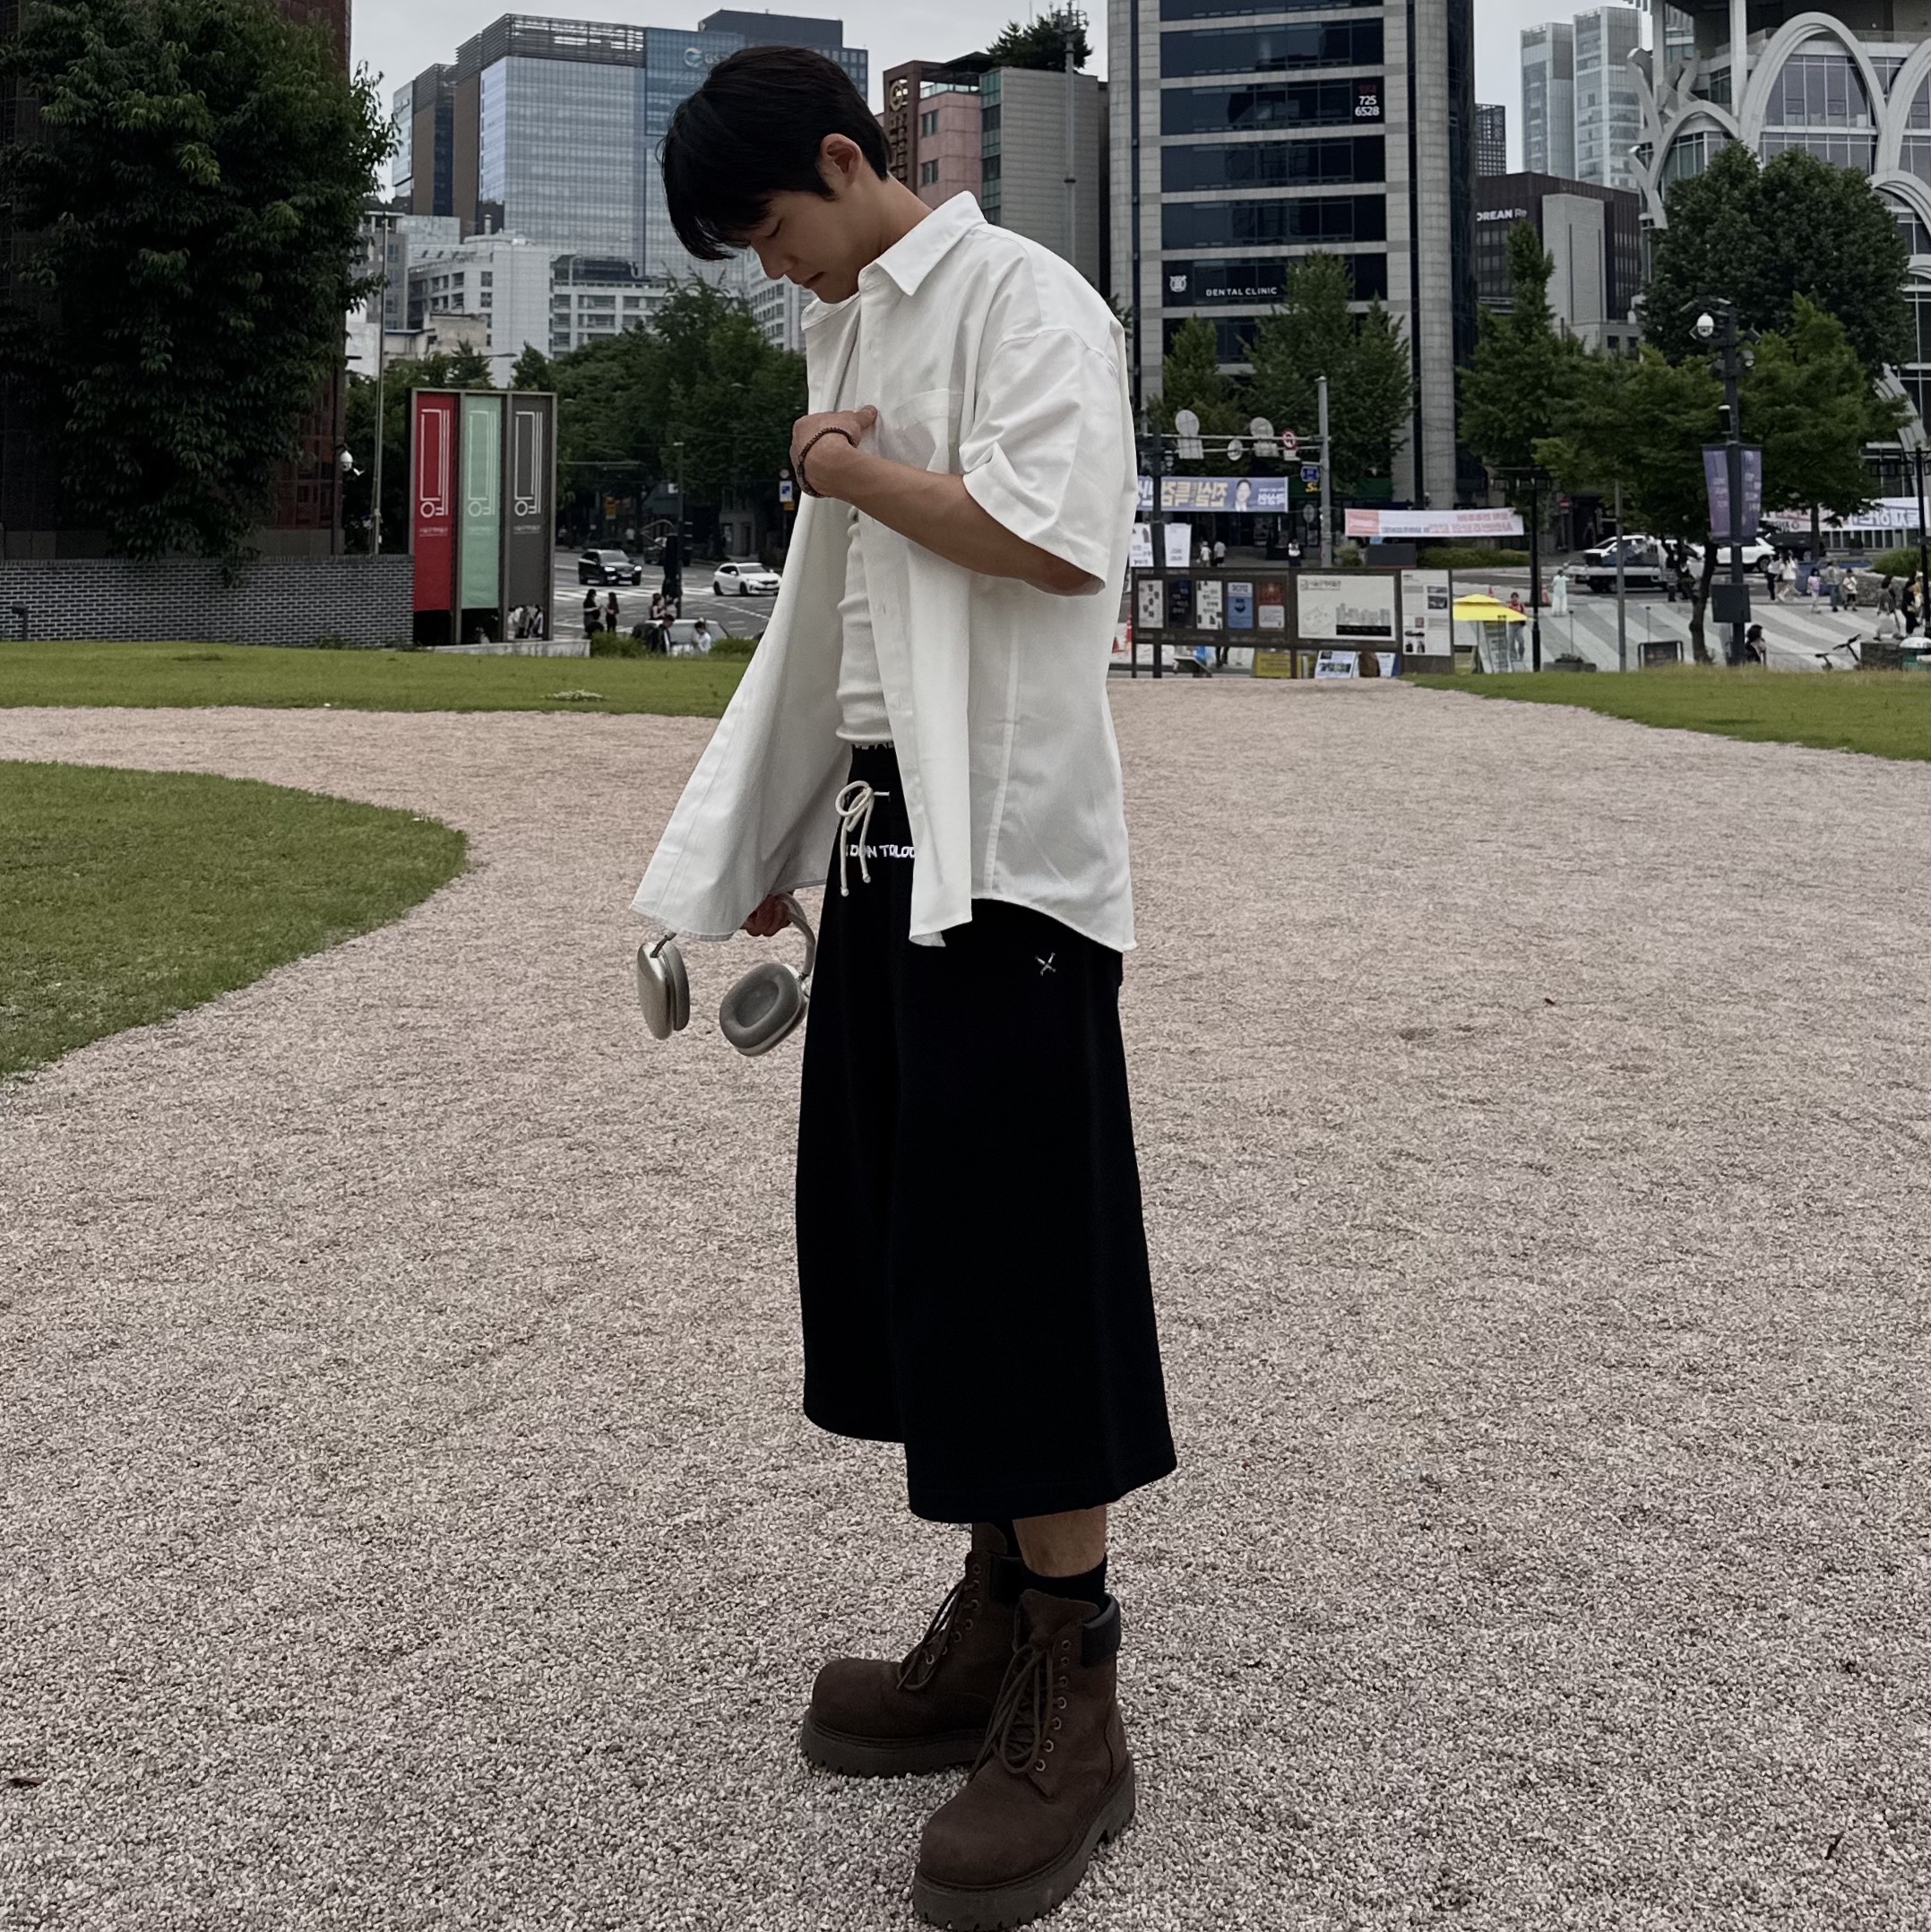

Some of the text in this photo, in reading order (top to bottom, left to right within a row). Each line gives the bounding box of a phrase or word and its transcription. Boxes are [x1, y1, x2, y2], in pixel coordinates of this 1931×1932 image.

[1358, 95, 1377, 106] 725
[1355, 106, 1380, 116] 6528
[1206, 287, 1278, 297] DENTAL CLINIC
